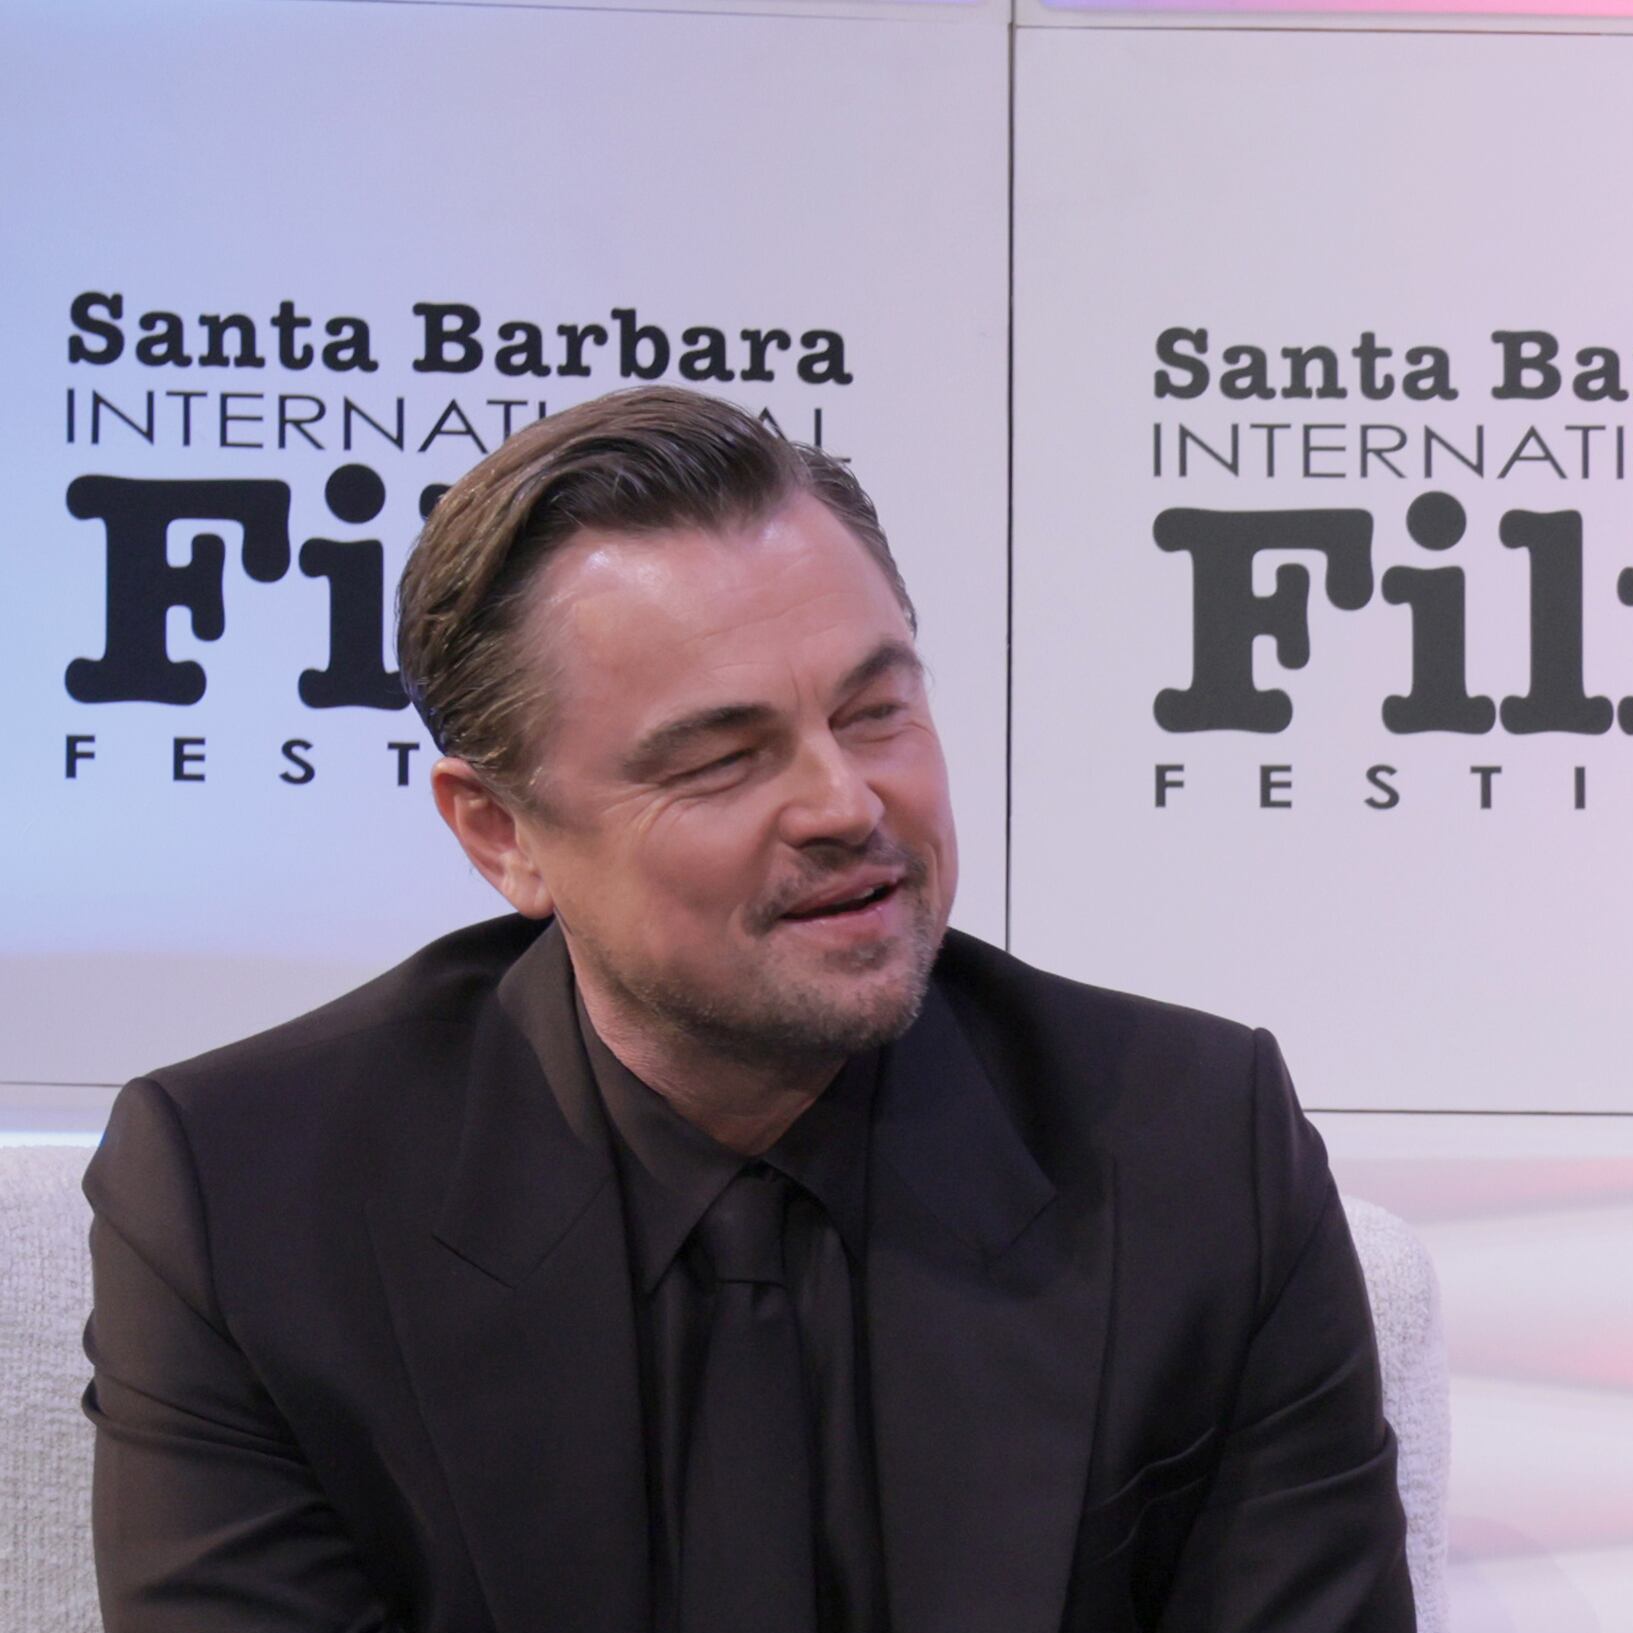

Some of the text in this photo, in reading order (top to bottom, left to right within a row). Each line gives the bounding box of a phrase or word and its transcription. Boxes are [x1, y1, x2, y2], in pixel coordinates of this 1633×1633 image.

[68, 291, 854, 385] Santa Barbara
[1154, 326, 1459, 401] Santa
[64, 463, 452, 710] Fi
[65, 735, 420, 787] FEST
